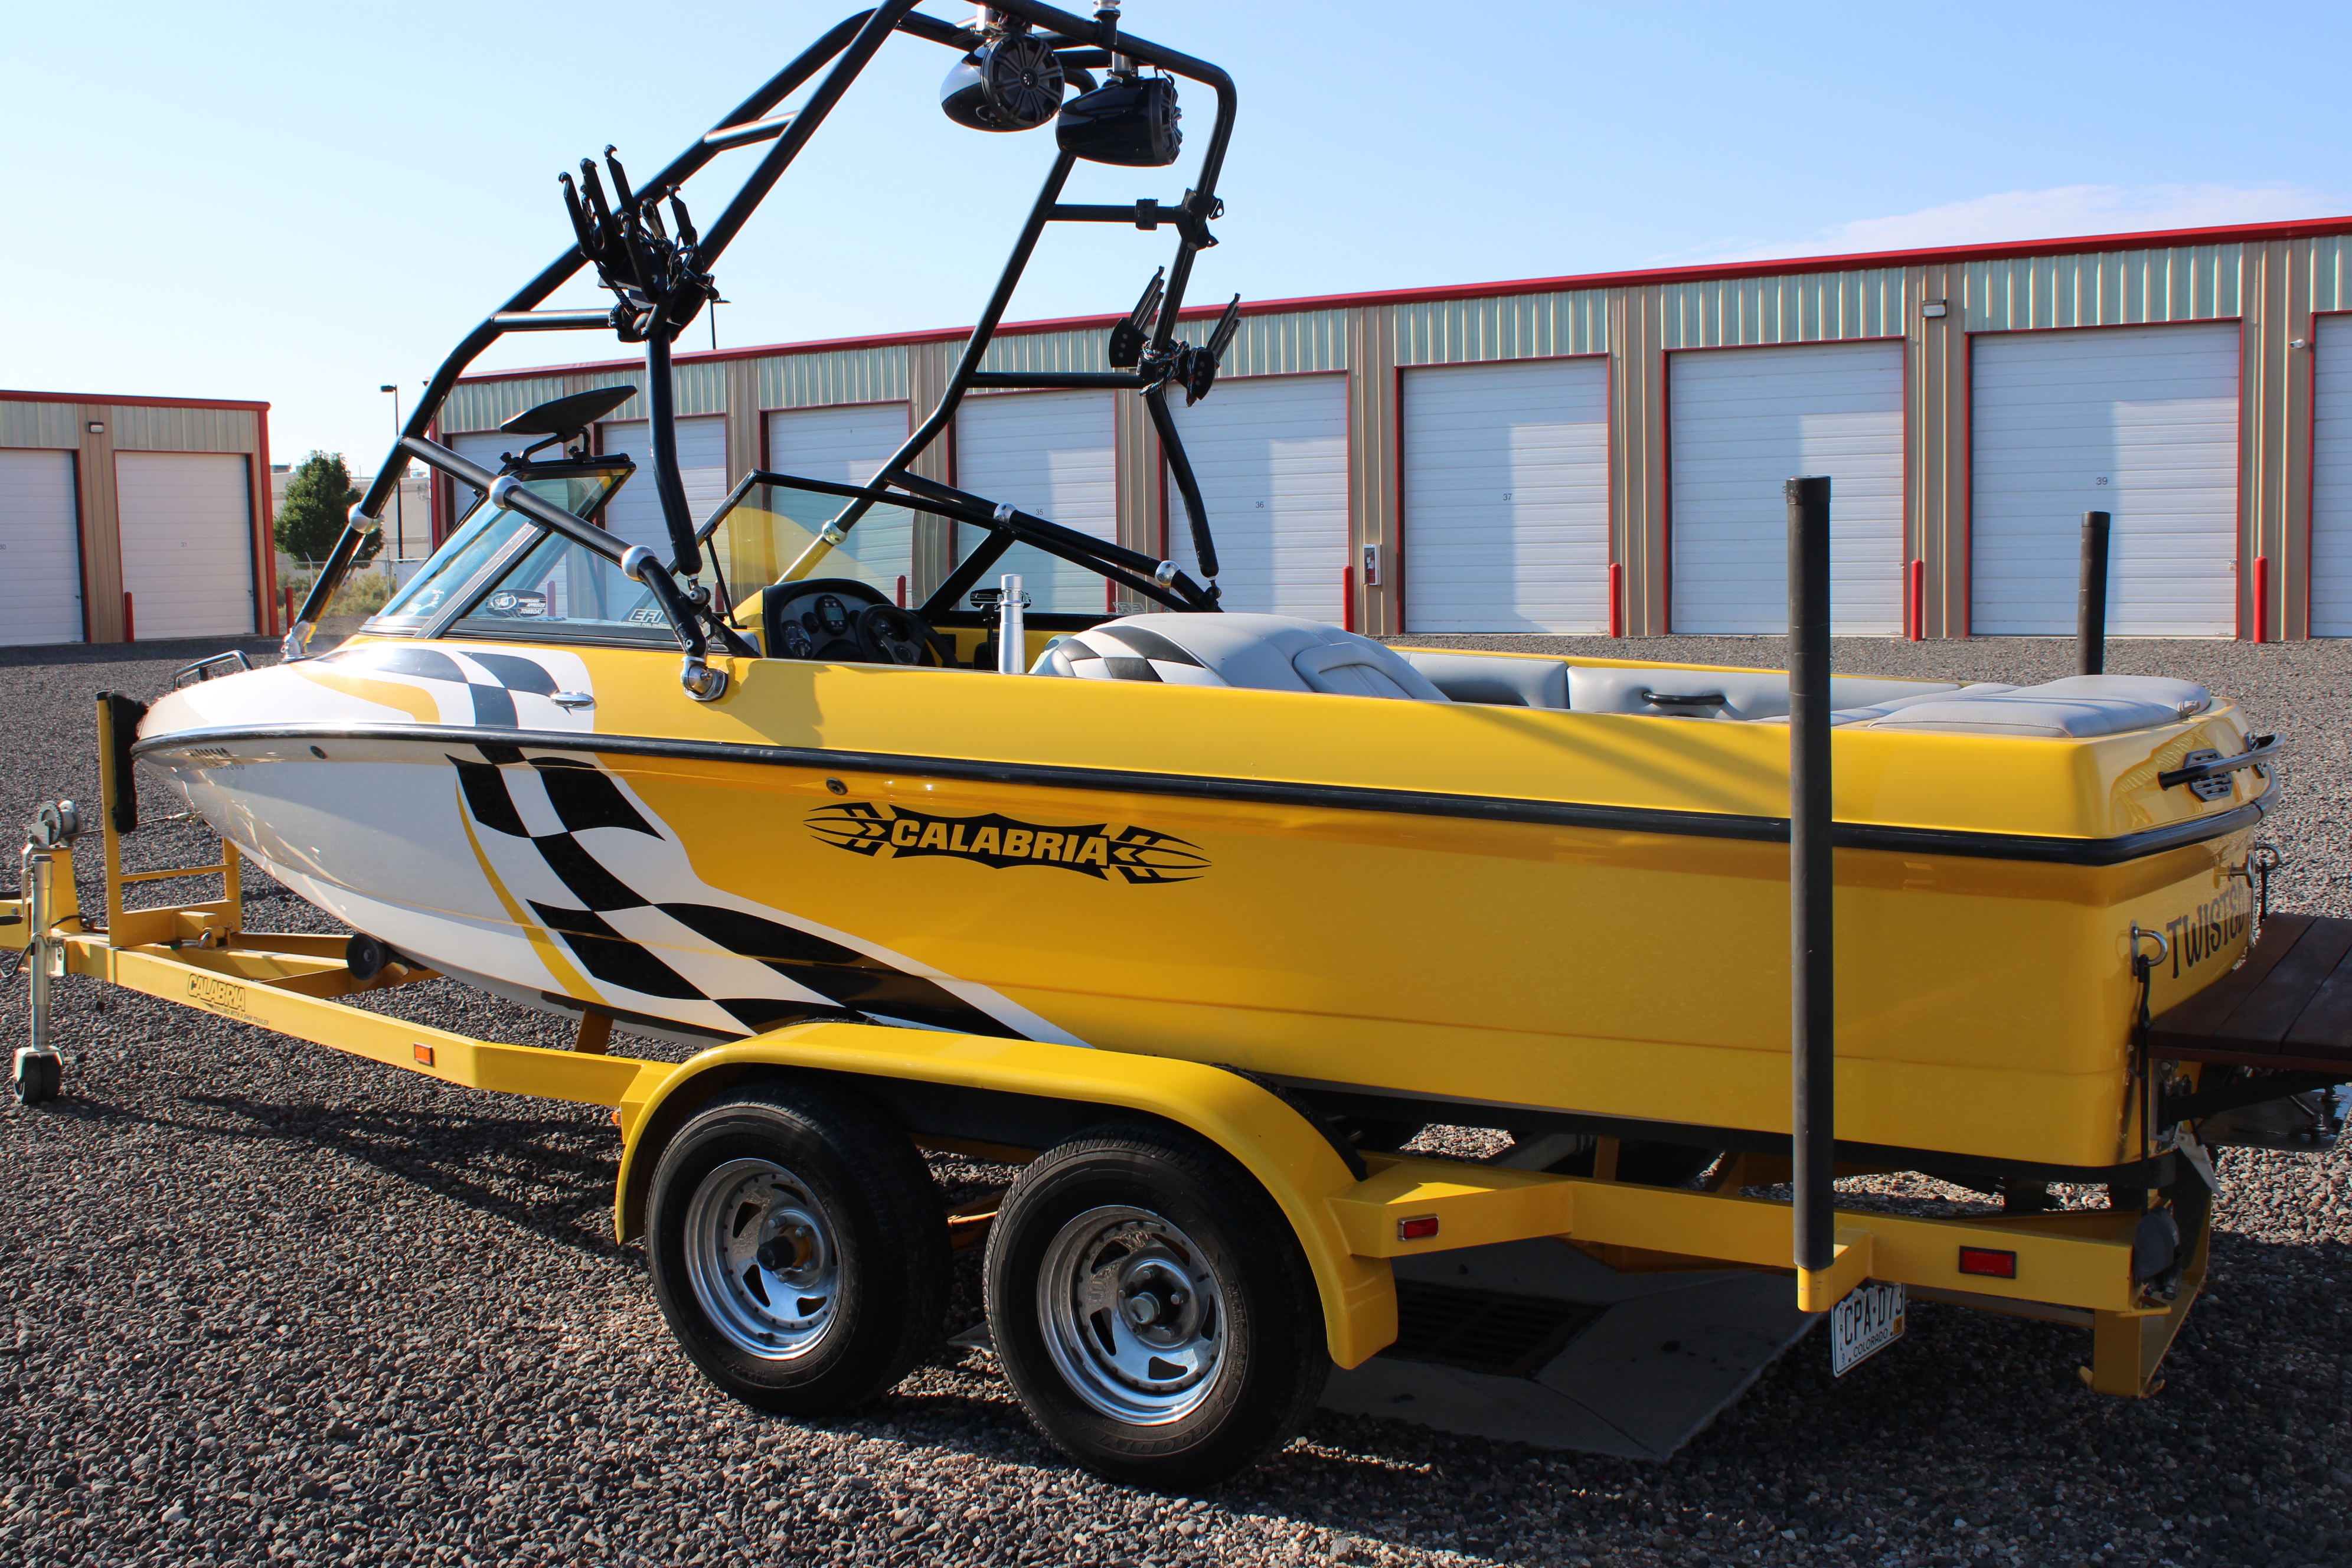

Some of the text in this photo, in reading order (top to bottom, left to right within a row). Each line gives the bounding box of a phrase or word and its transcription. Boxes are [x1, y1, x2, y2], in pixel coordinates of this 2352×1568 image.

[2096, 476, 2108, 485] 39
[628, 609, 664, 623] EFI
[891, 819, 1108, 866] CALABRIA
[188, 974, 246, 1012] CALABRIA
[253, 1016, 269, 1026] TRAILER
[1853, 1328, 1888, 1358] COLORADO
